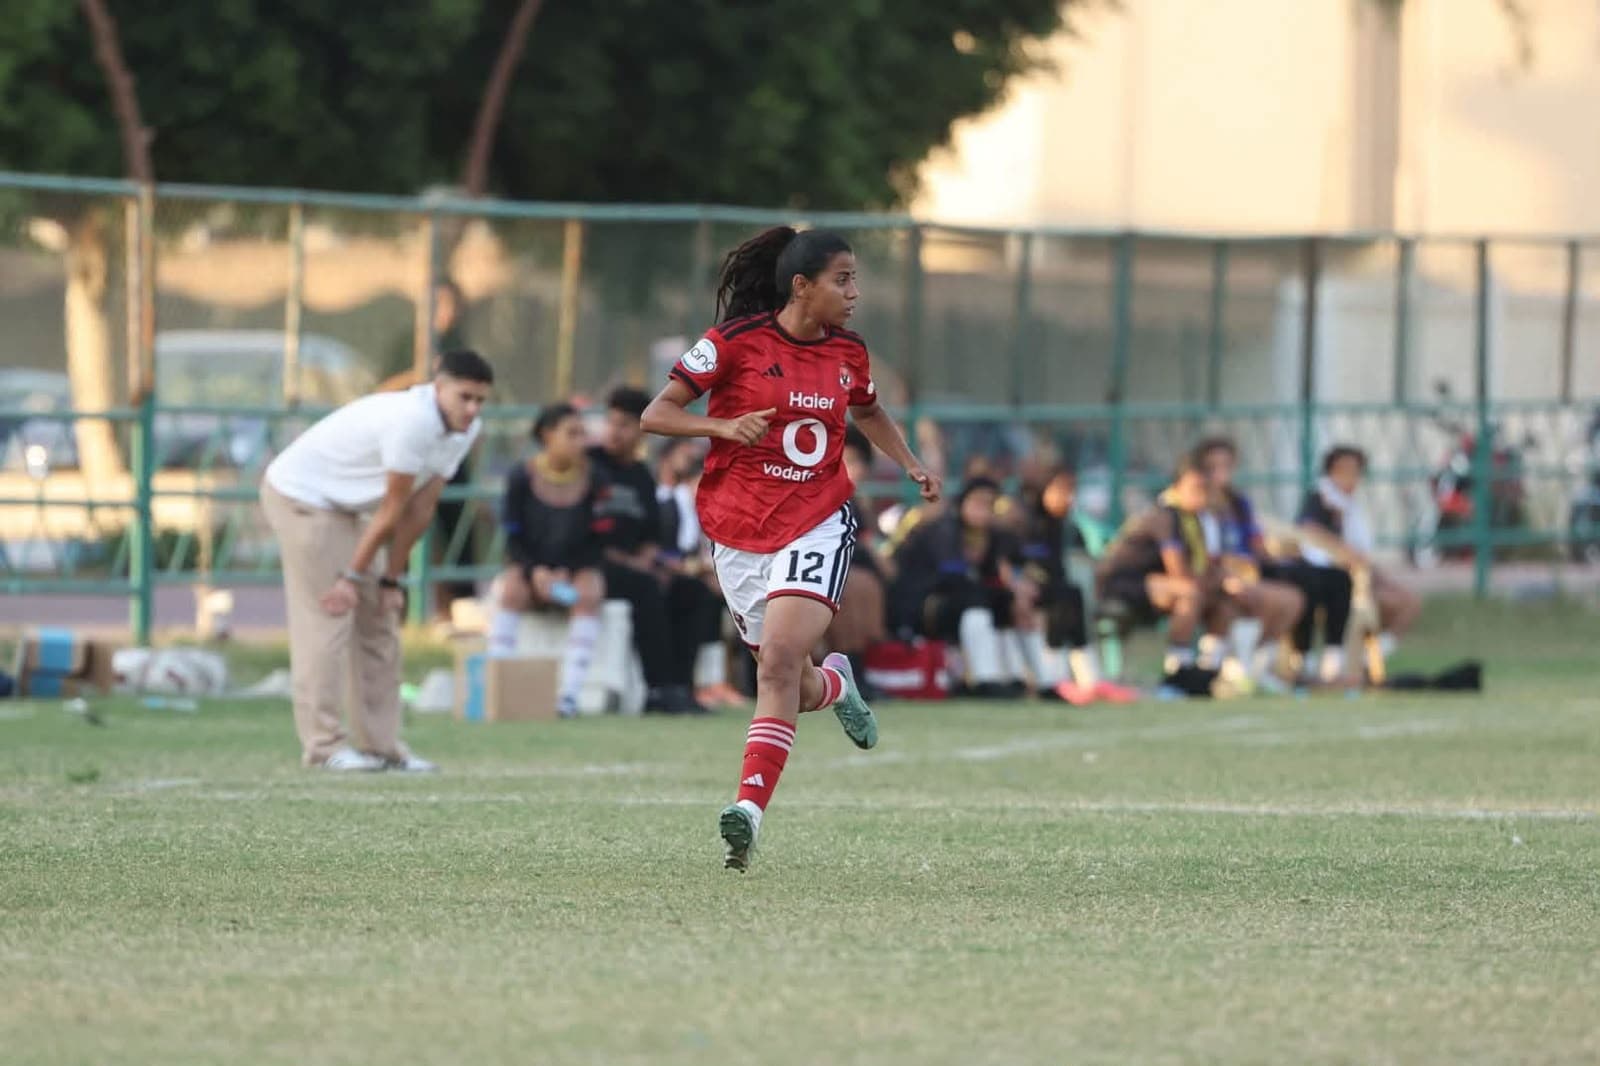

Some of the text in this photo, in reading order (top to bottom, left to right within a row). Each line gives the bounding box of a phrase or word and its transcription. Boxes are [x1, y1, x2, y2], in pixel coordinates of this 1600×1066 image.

[789, 391, 835, 410] Haier
[763, 462, 822, 482] vodaf
[785, 550, 825, 585] 12
